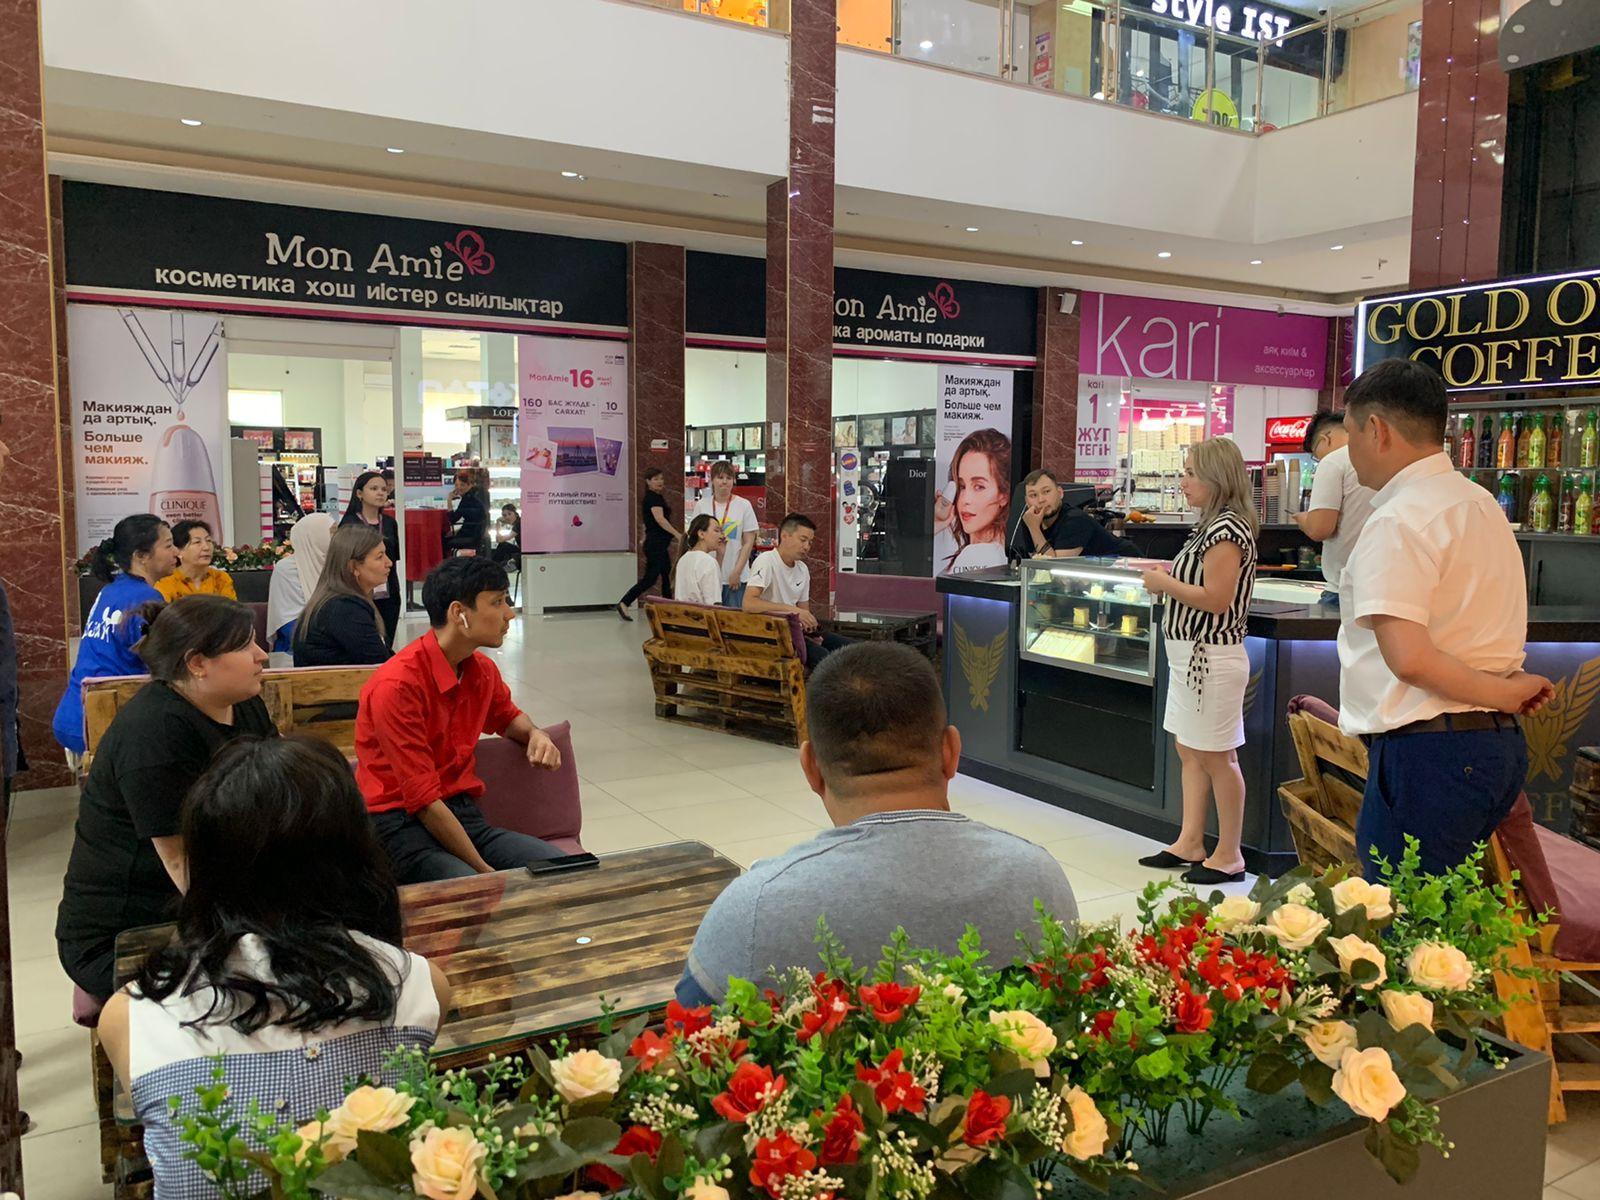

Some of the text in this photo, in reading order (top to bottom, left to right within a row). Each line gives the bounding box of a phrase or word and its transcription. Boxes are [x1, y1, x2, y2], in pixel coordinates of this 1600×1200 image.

[1240, 6, 1290, 47] IST
[265, 232, 464, 282] Mon Amie
[155, 268, 295, 294] косметика
[306, 280, 356, 298] хош
[445, 291, 564, 318] сыйлықтар
[832, 290, 937, 323] on Amie
[1367, 288, 1530, 345] GOLD
[832, 324, 985, 350] ка ароматы подарки
[1096, 293, 1223, 382] kari
[1263, 345, 1279, 357] аяқ
[1300, 347, 1308, 358] &
[569, 368, 594, 389] 16
[1254, 364, 1315, 380] аксессуарлар
[944, 374, 1001, 388] Макияждан
[1087, 380, 1104, 389] kari
[944, 387, 991, 398] да артық.
[83, 400, 172, 415] Макияждан
[522, 398, 543, 408] 160
[606, 402, 618, 411] 10
[944, 399, 1002, 411] Больше чем
[1088, 393, 1098, 424] 1
[83, 414, 157, 427] да артық.
[943, 411, 984, 420] макияж.
[84, 430, 143, 443] Больше
[84, 444, 114, 454] чем
[85, 455, 149, 465] макияж.
[909, 469, 928, 479] Dior
[160, 499, 208, 511] CLINIQUE
